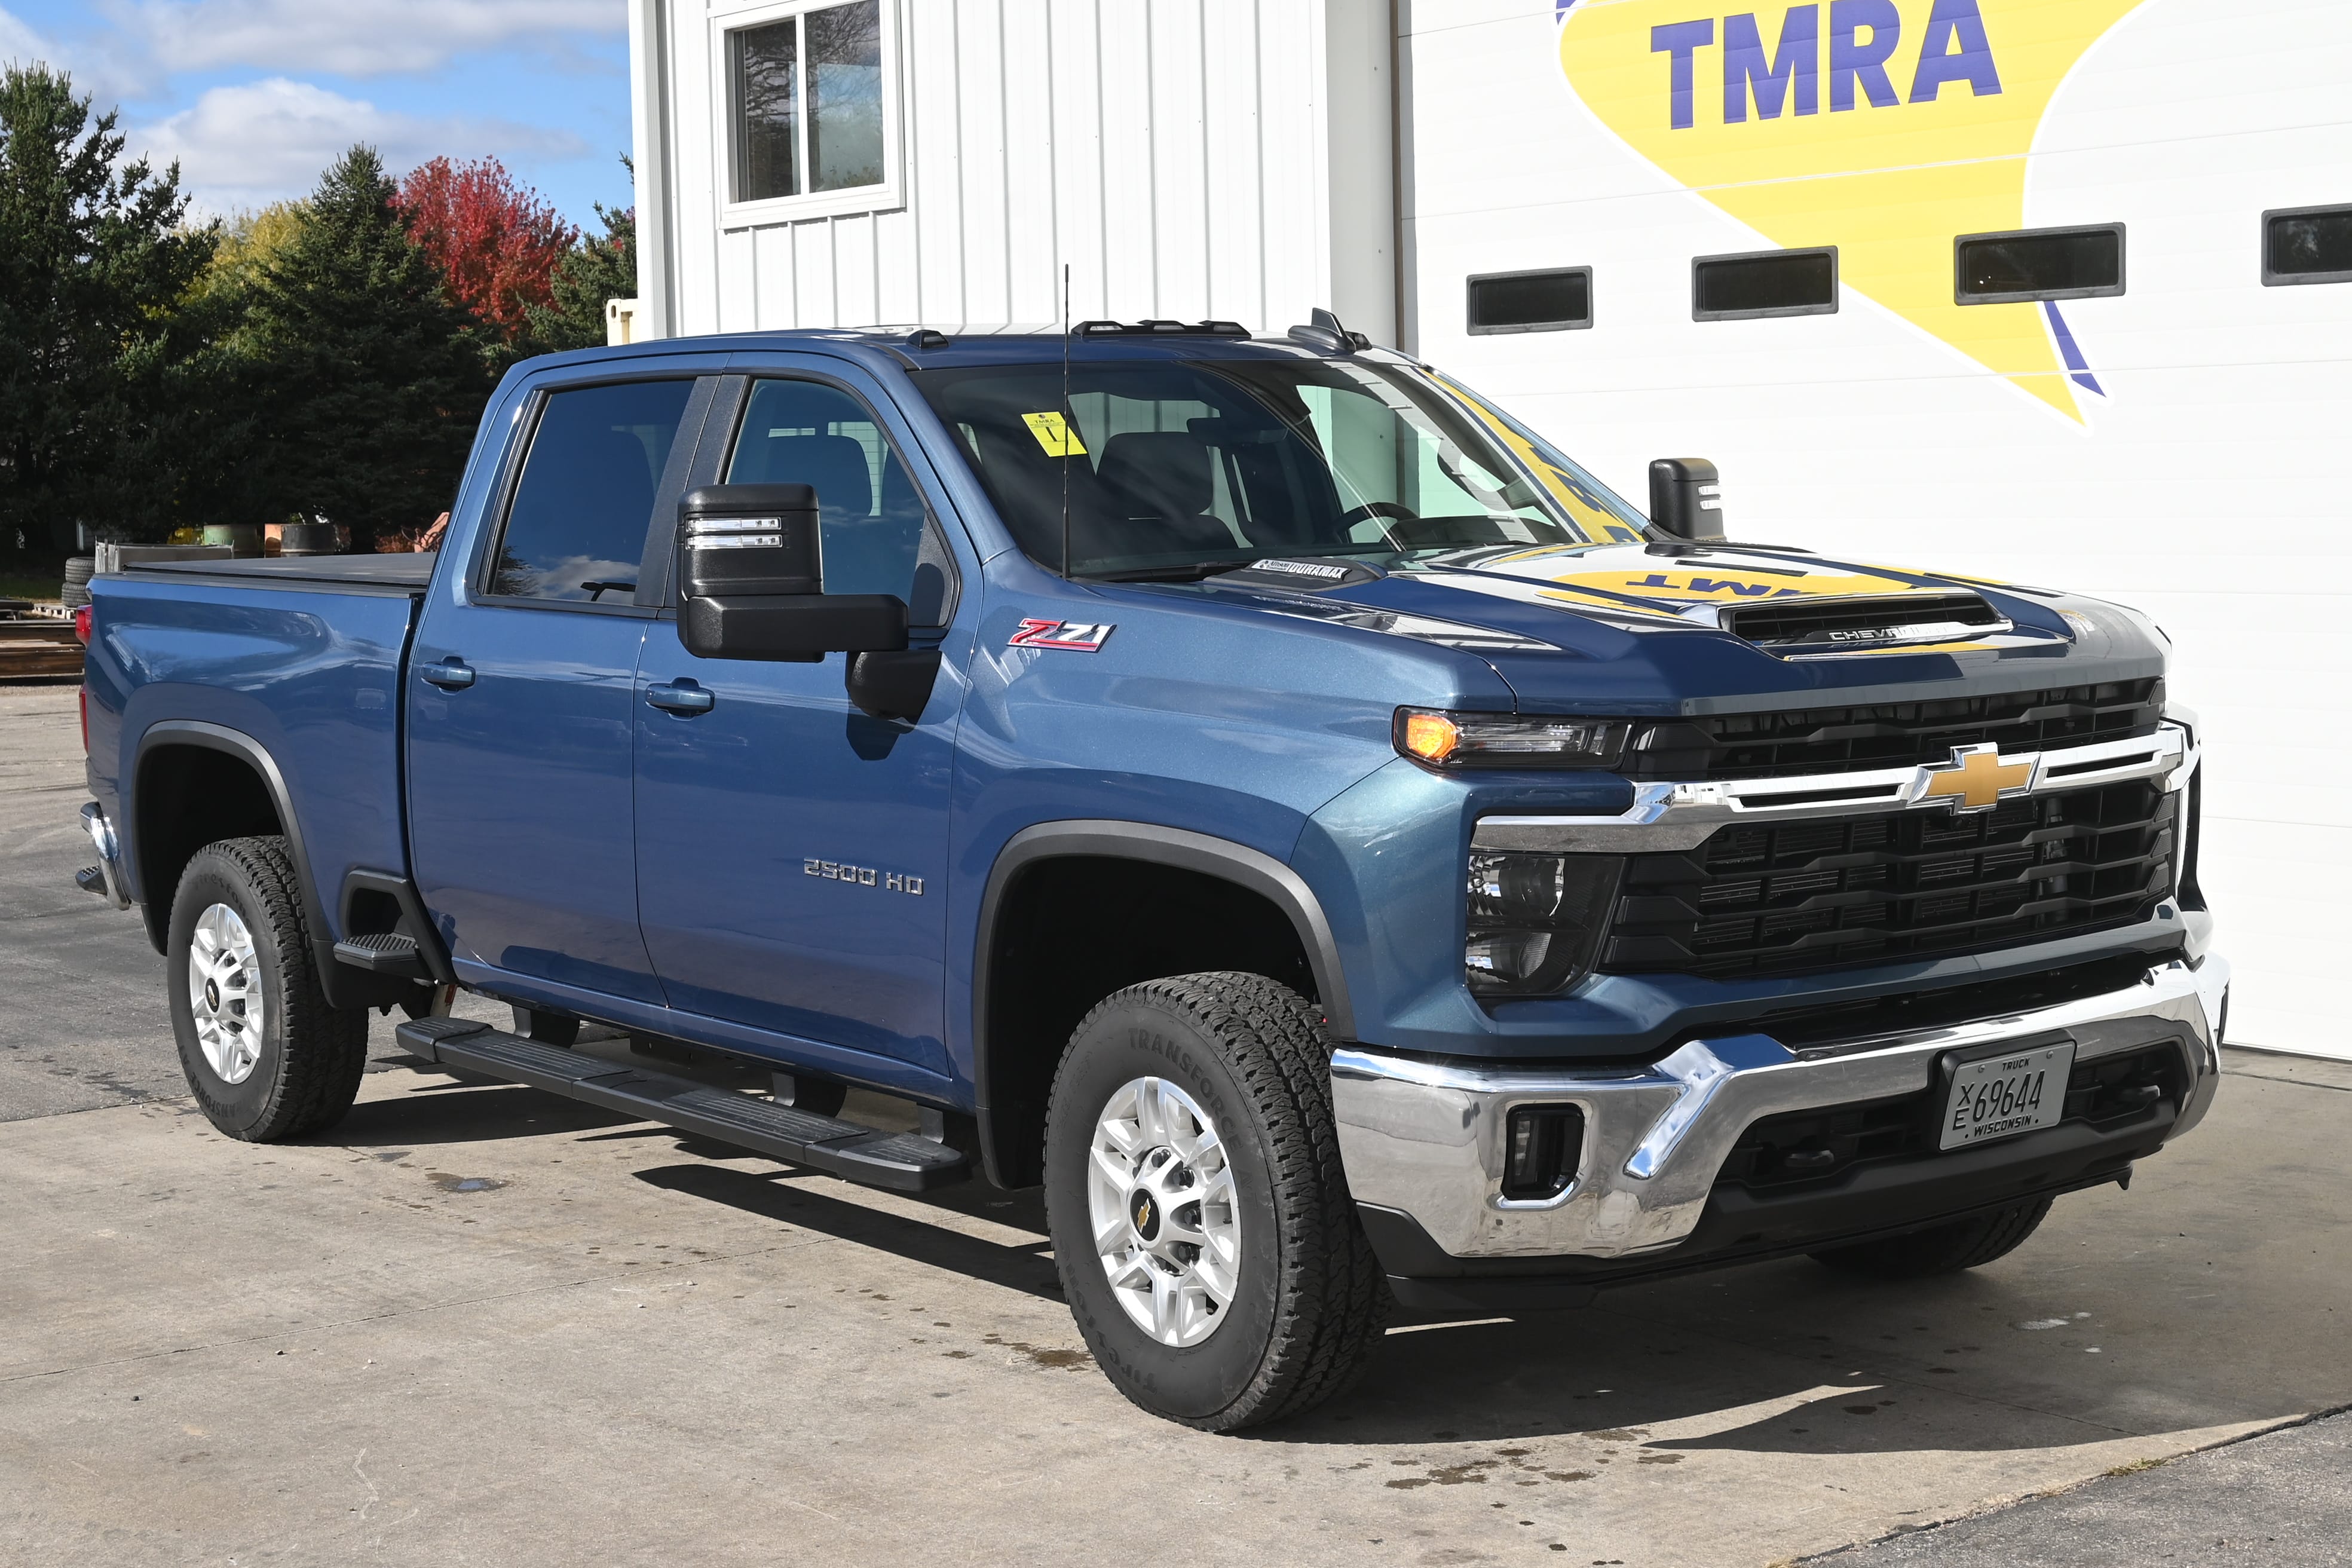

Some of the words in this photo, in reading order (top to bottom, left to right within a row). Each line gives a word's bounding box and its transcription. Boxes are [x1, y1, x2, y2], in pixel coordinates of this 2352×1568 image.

[1650, 0, 2002, 130] TMRA
[1287, 563, 1349, 580] DURAMAX
[1006, 617, 1117, 653] Z71
[804, 858, 877, 887] 2500
[886, 871, 924, 896] HD
[2002, 1057, 2031, 1071] TRUCK
[1128, 1027, 1244, 1154] TRANSFORCE
[1973, 1070, 2045, 1122] 69644
[1974, 1114, 2032, 1137] WISCONSIN
